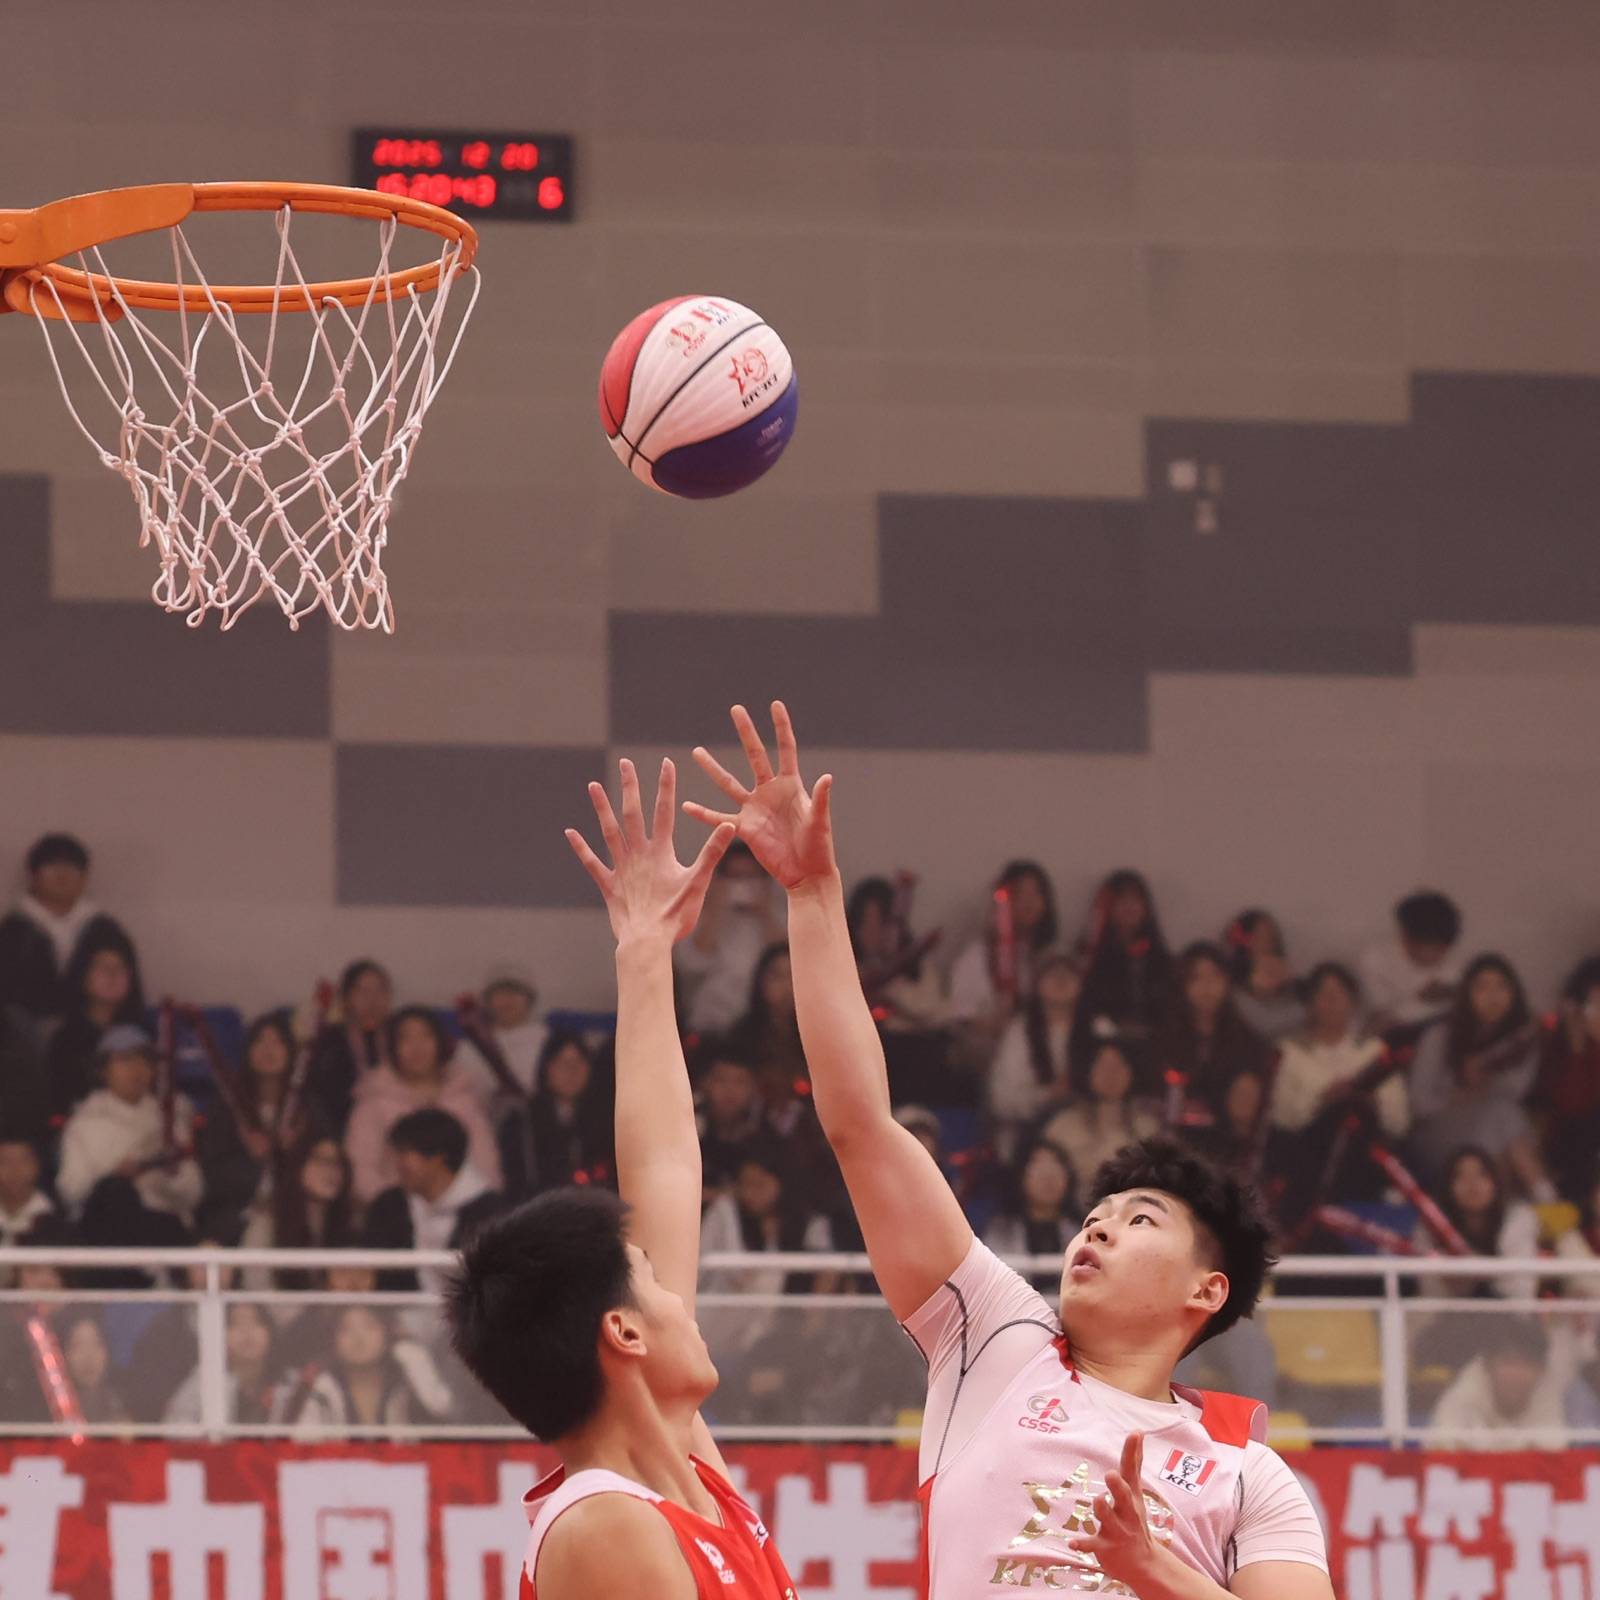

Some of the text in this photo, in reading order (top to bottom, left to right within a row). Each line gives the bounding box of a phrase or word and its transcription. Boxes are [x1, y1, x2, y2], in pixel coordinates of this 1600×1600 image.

[1018, 1416, 1061, 1435] CSSF
[1166, 1473, 1196, 1491] KFC
[989, 1557, 1069, 1590] KFC
